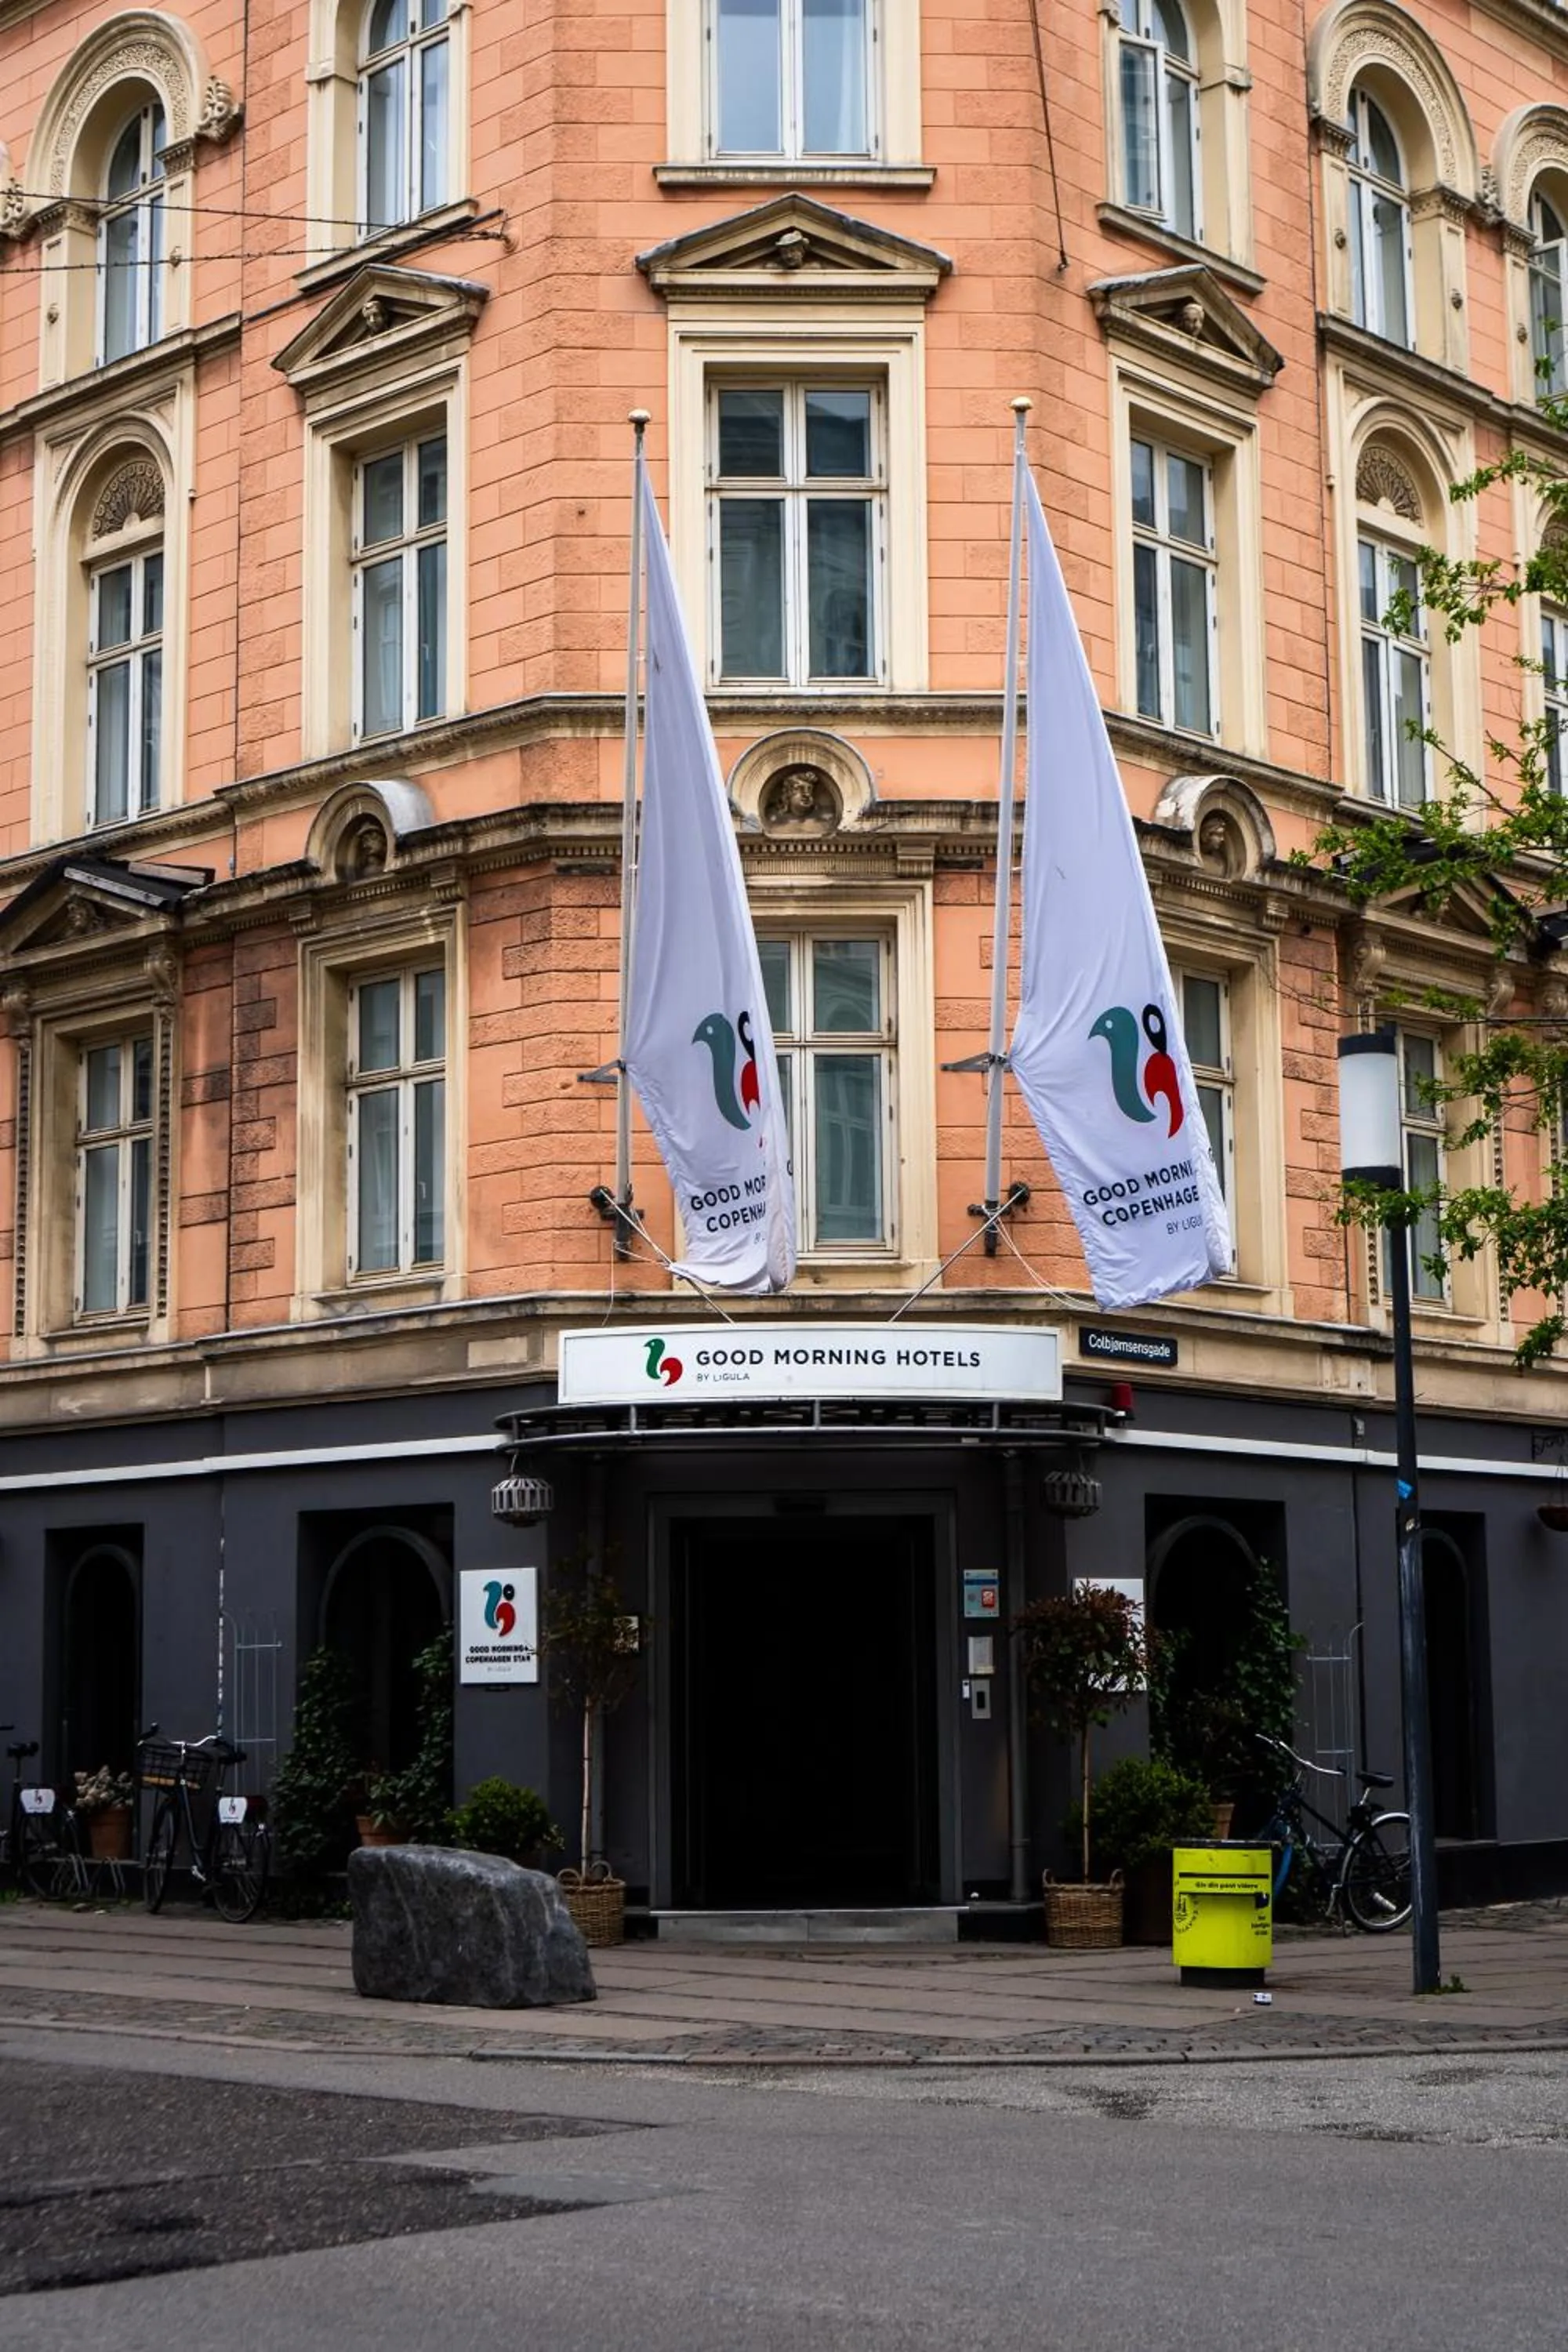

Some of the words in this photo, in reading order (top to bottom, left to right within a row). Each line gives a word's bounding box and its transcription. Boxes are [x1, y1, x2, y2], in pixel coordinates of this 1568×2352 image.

[691, 1185, 741, 1210] GOOD
[1083, 1178, 1139, 1206] GOOD
[1102, 1185, 1200, 1226] COPENHAGE
[1167, 1221, 1179, 1235] BY
[696, 1349, 764, 1366] GOOD
[774, 1348, 887, 1366] MORNING
[896, 1349, 981, 1367] HOTELS
[696, 1373, 710, 1382] BY
[713, 1373, 750, 1382] LIGULA
